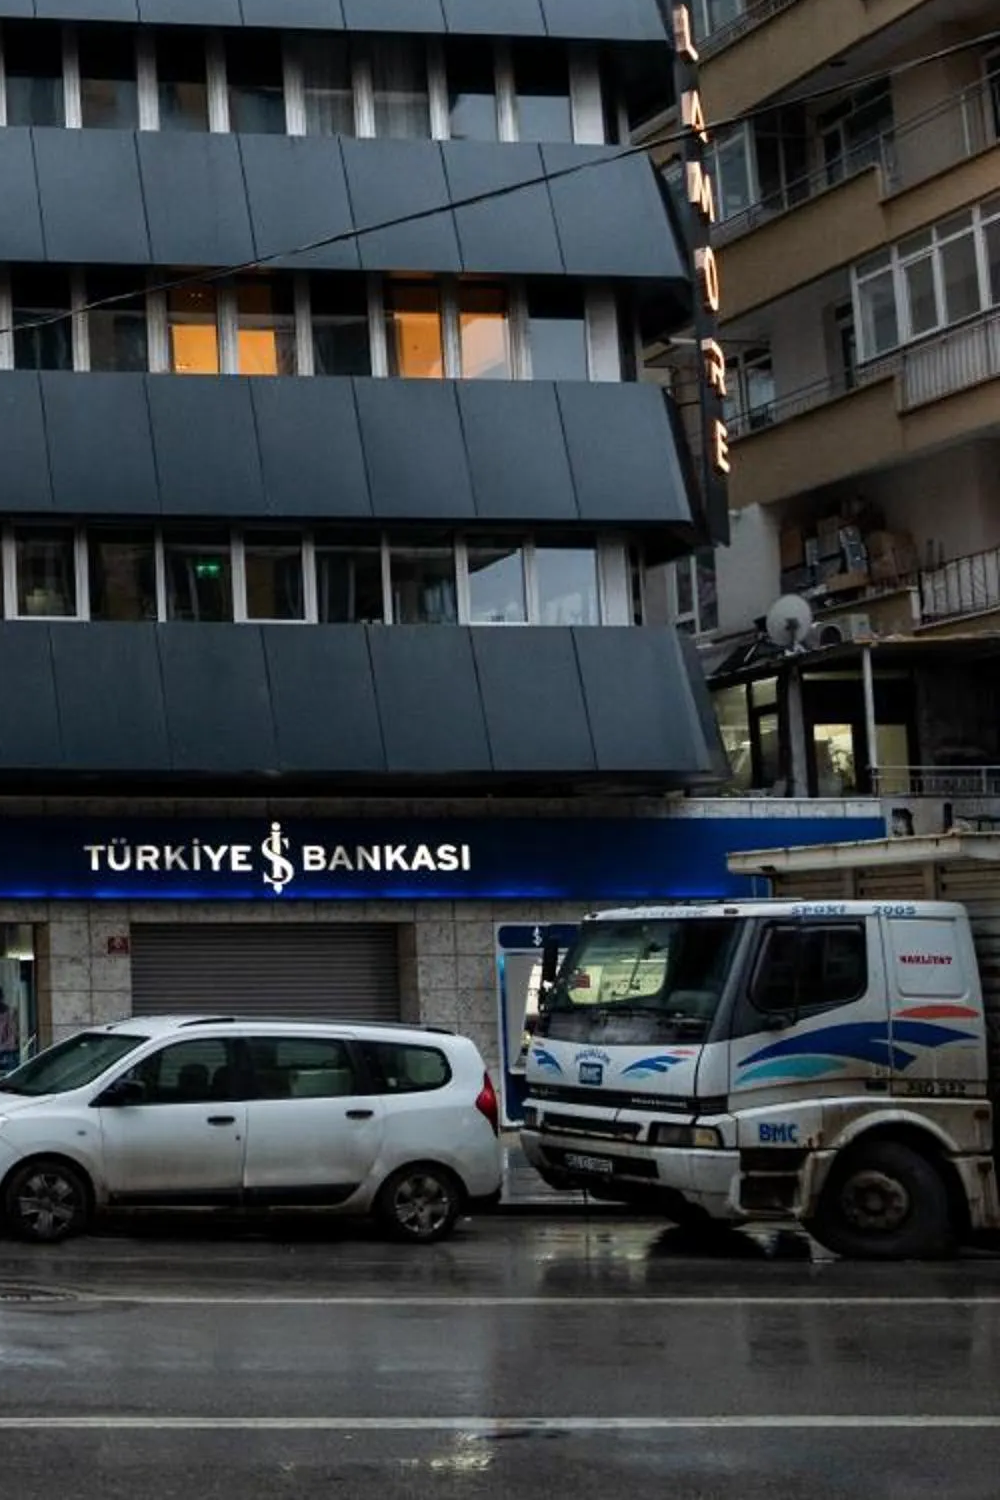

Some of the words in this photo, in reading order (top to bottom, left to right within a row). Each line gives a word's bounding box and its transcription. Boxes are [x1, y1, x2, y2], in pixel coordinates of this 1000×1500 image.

[83, 838, 253, 872] TÜRKİYE
[303, 844, 471, 872] BANKASI
[758, 1123, 799, 1143] BMC
